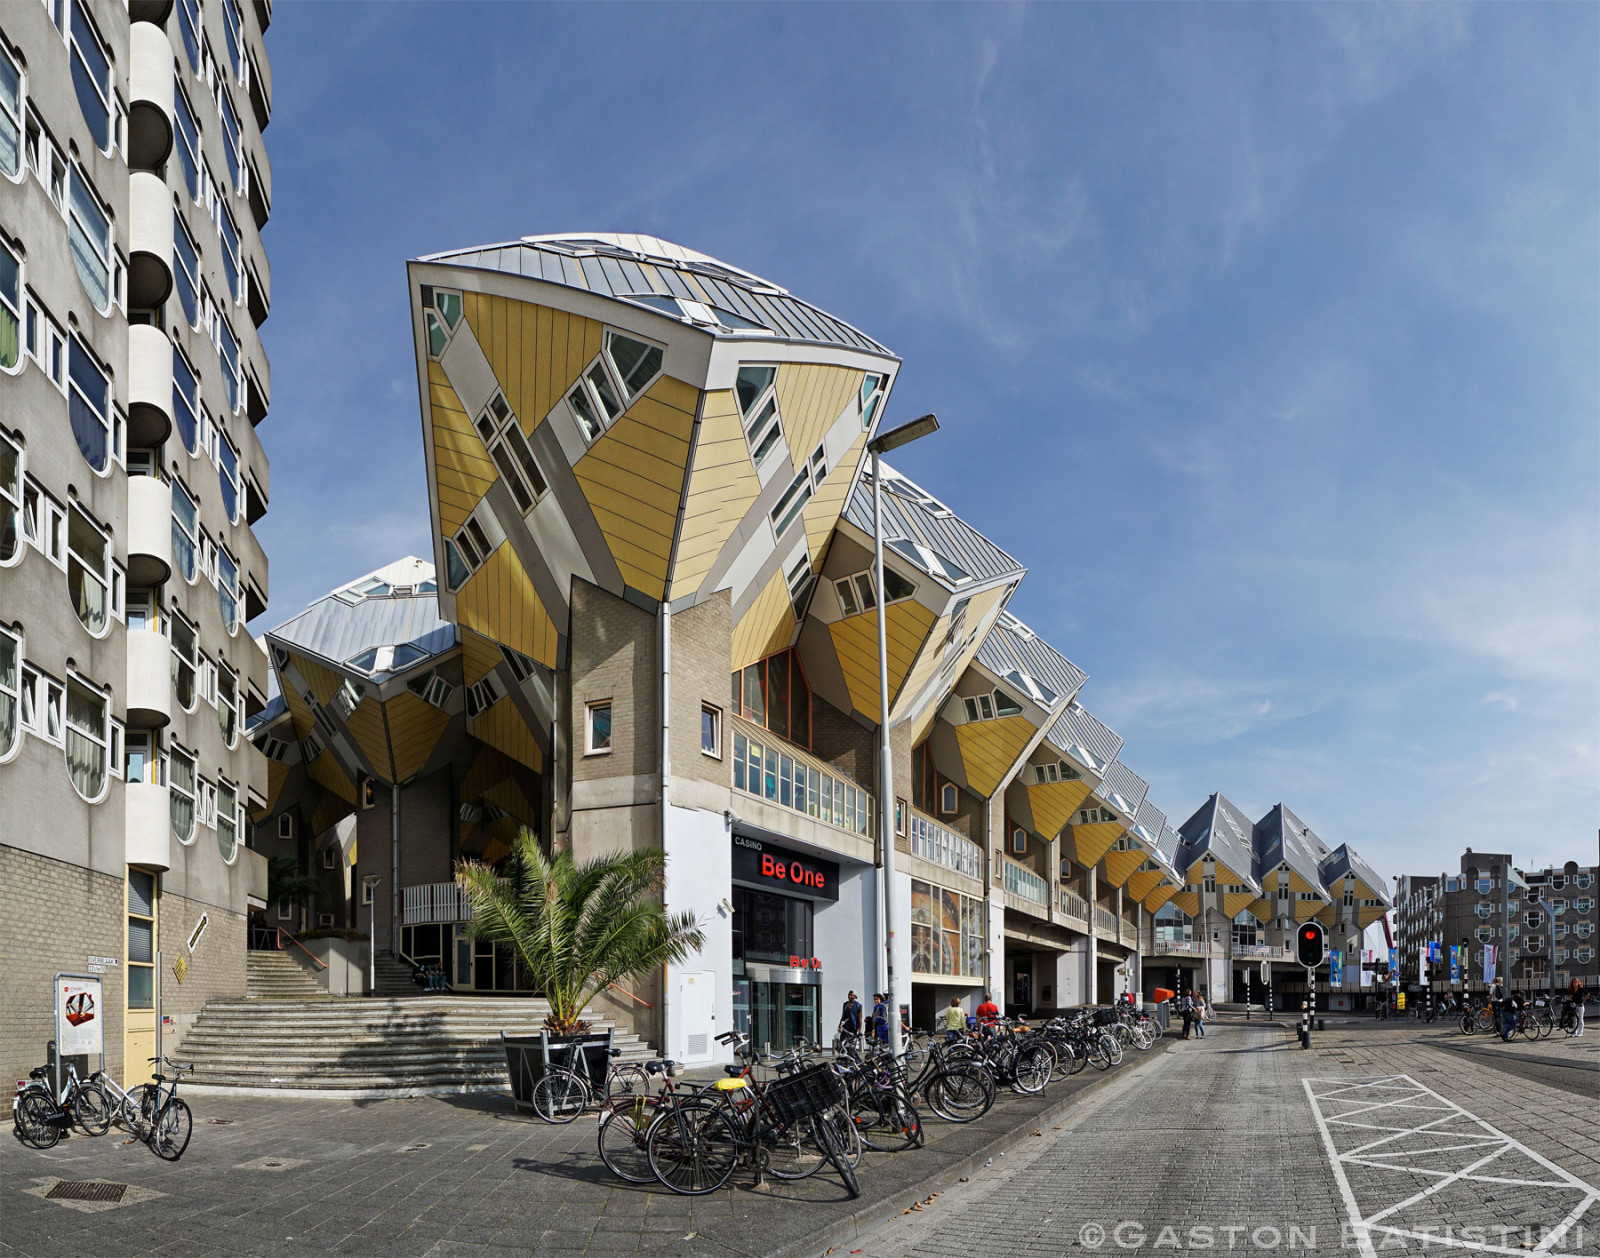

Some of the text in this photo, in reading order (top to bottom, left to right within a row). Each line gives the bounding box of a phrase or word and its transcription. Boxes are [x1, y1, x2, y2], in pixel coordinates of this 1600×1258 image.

[735, 837, 762, 850] CASINO
[762, 854, 824, 888] Be One
[790, 956, 808, 968] Be
